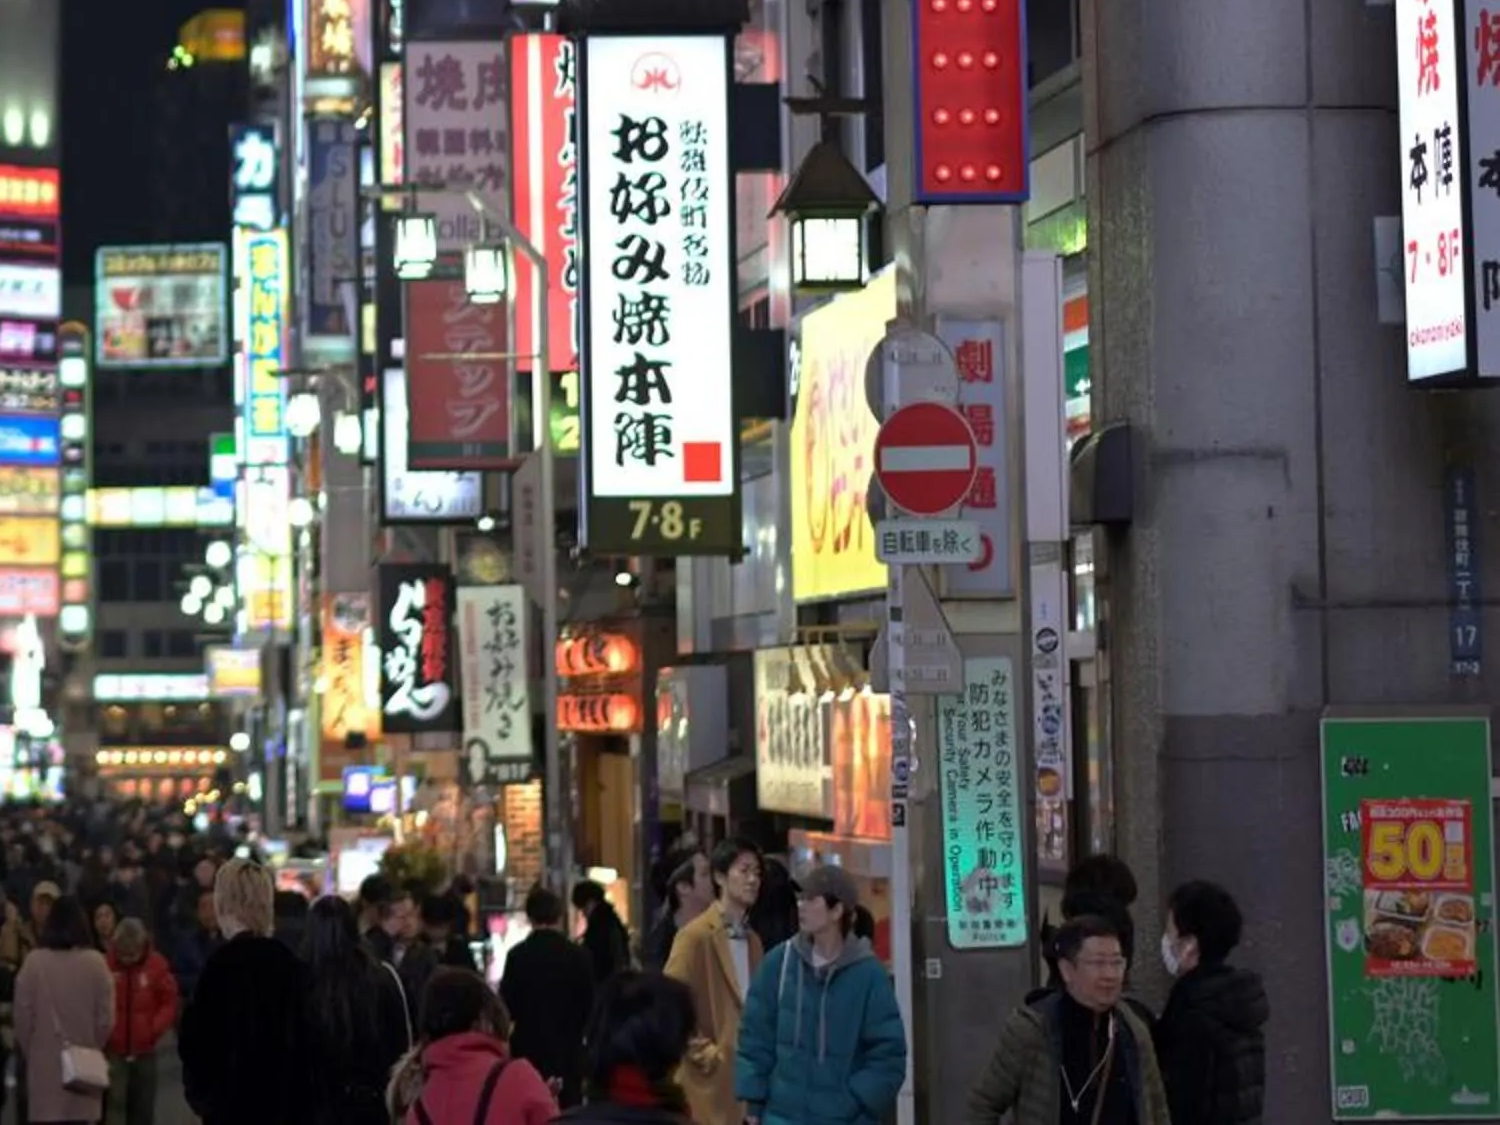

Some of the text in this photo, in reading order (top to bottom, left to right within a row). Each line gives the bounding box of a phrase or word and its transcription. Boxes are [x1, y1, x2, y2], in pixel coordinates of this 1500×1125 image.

[610, 112, 672, 467] お好み焼本陣
[882, 529, 973, 555] 自転車を除く
[1455, 625, 1477, 648] 17
[943, 707, 958, 764] Security
[946, 769, 960, 823] Camera
[968, 682, 1000, 898] 防犯カメラ作動中
[990, 668, 1016, 911] みなさまの安全を守ります
[948, 844, 964, 912] Operation
